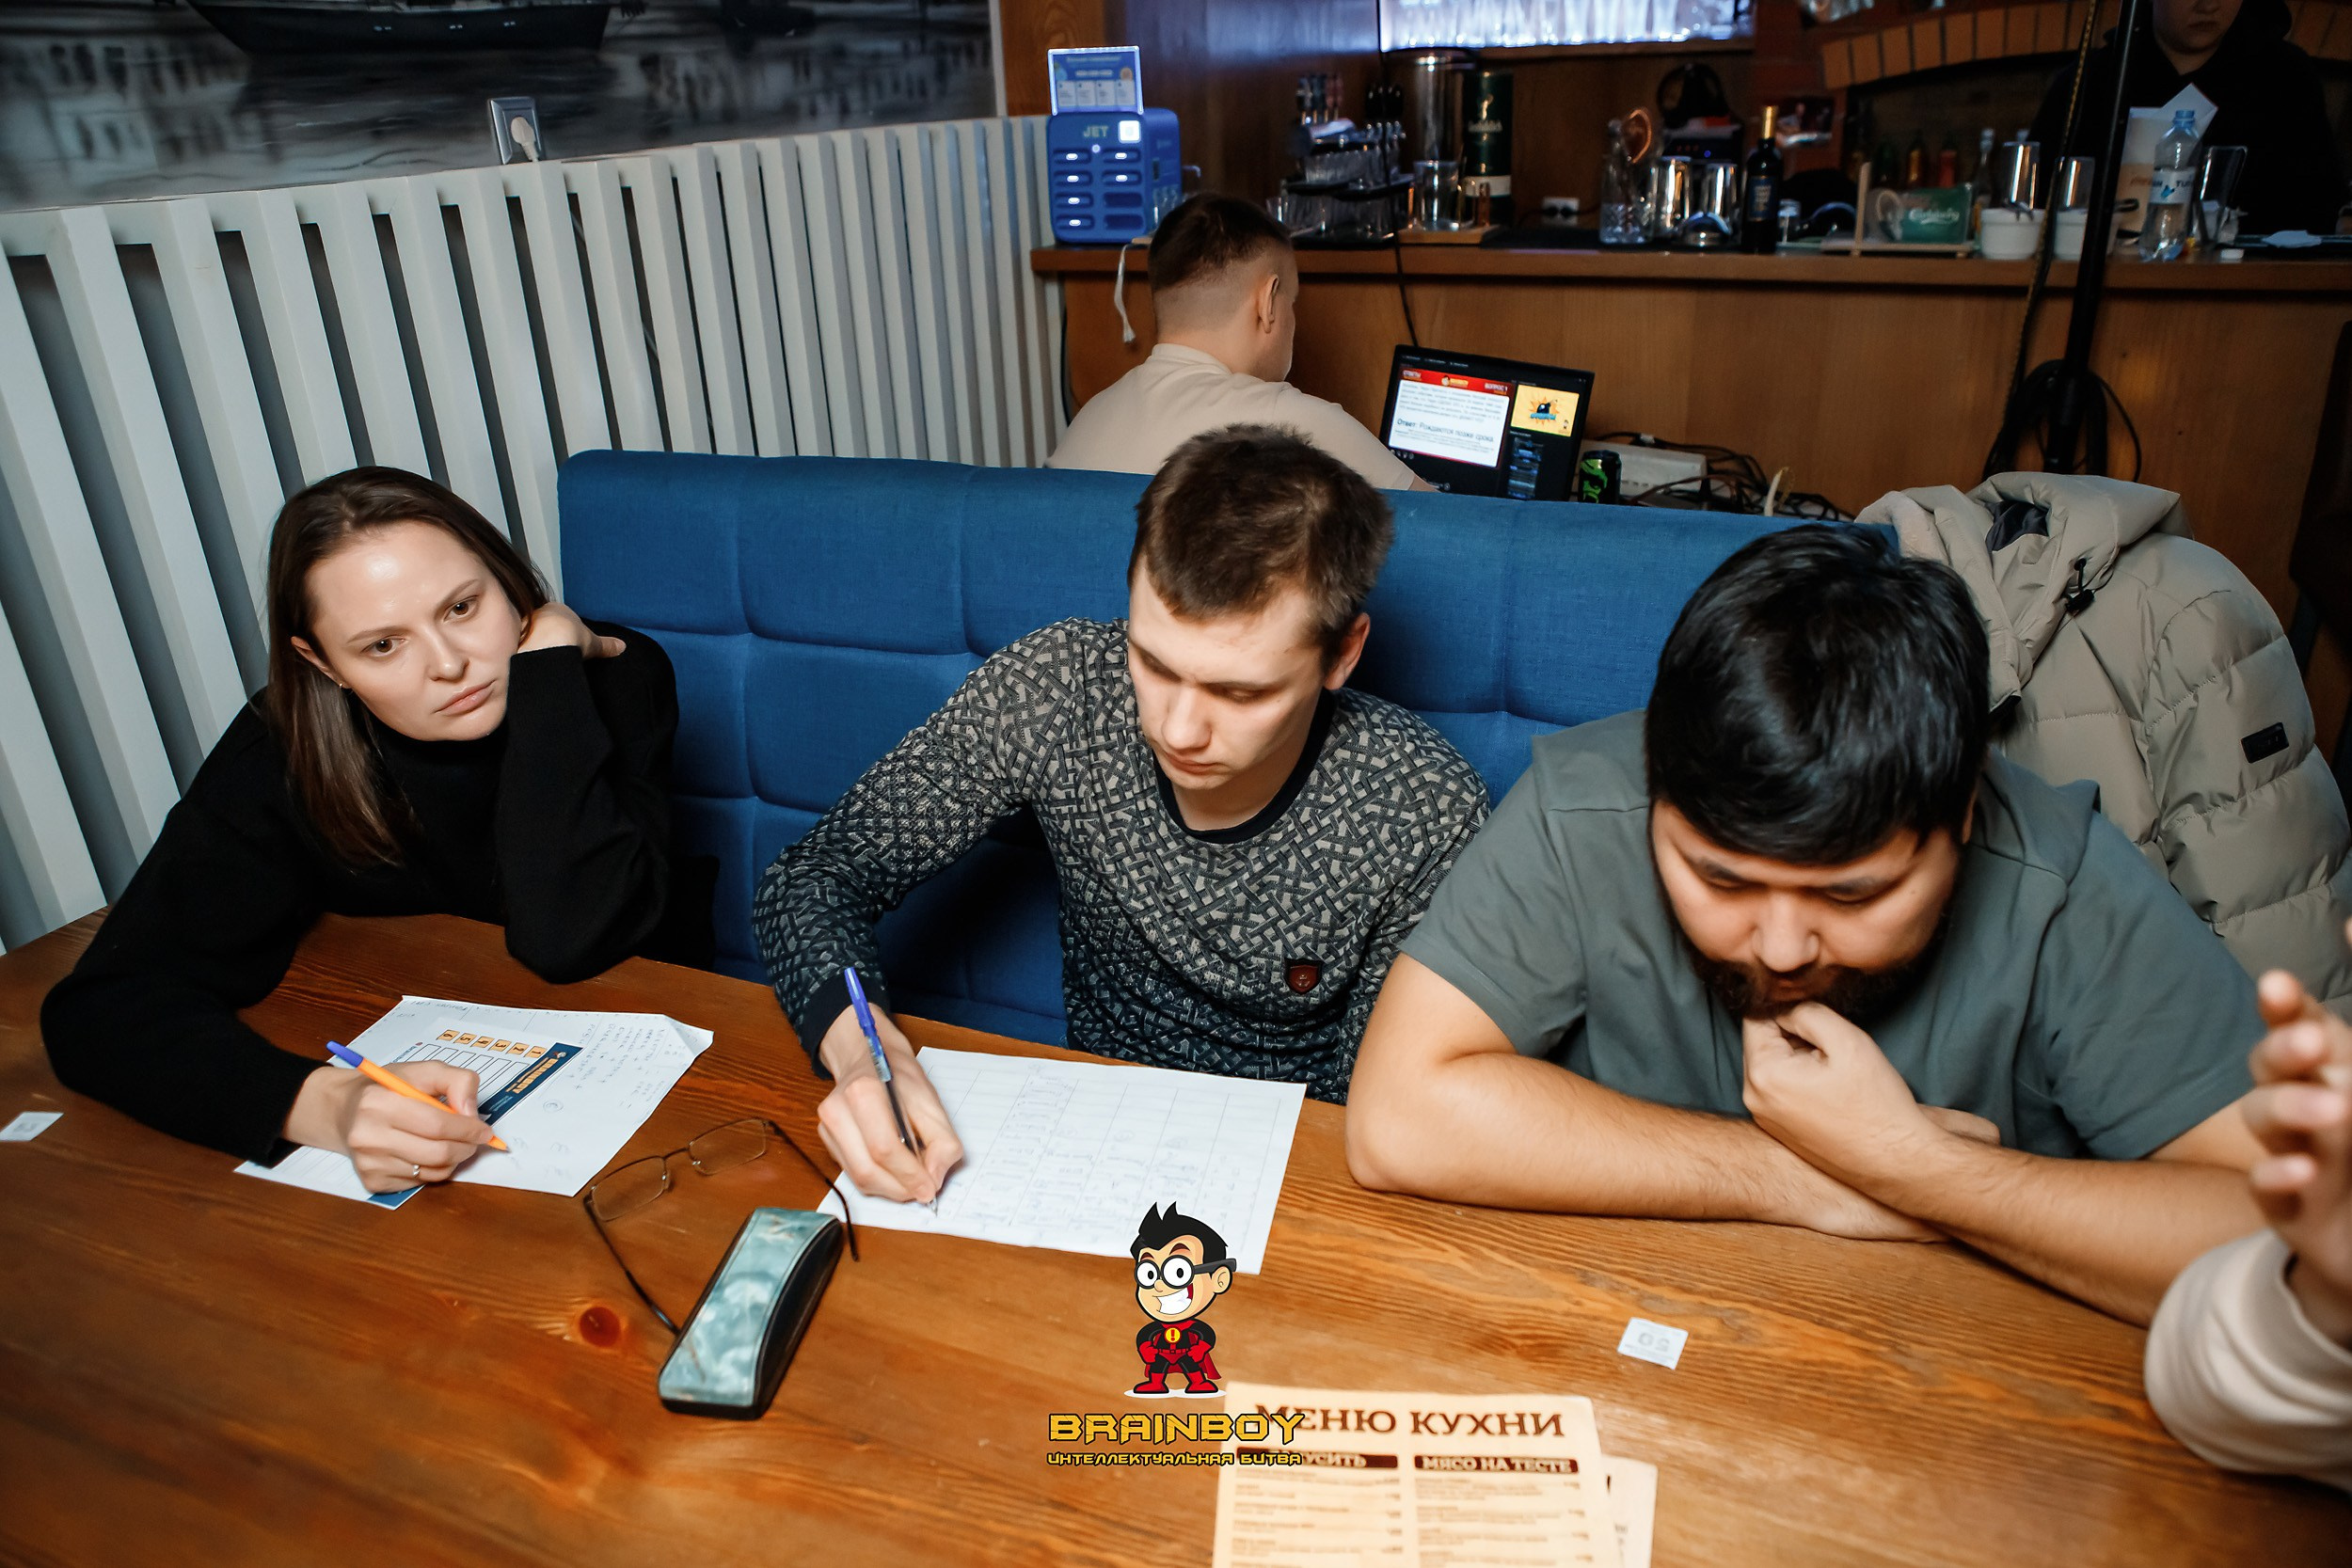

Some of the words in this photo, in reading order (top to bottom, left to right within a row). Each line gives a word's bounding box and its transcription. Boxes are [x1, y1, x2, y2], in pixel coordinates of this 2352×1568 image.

[1409, 1411, 1565, 1436] КУХНИ
[1422, 1457, 1477, 1470] МЯСО
[1480, 1457, 1510, 1471] НА
[1510, 1458, 1572, 1473] ТЕСТЕ
